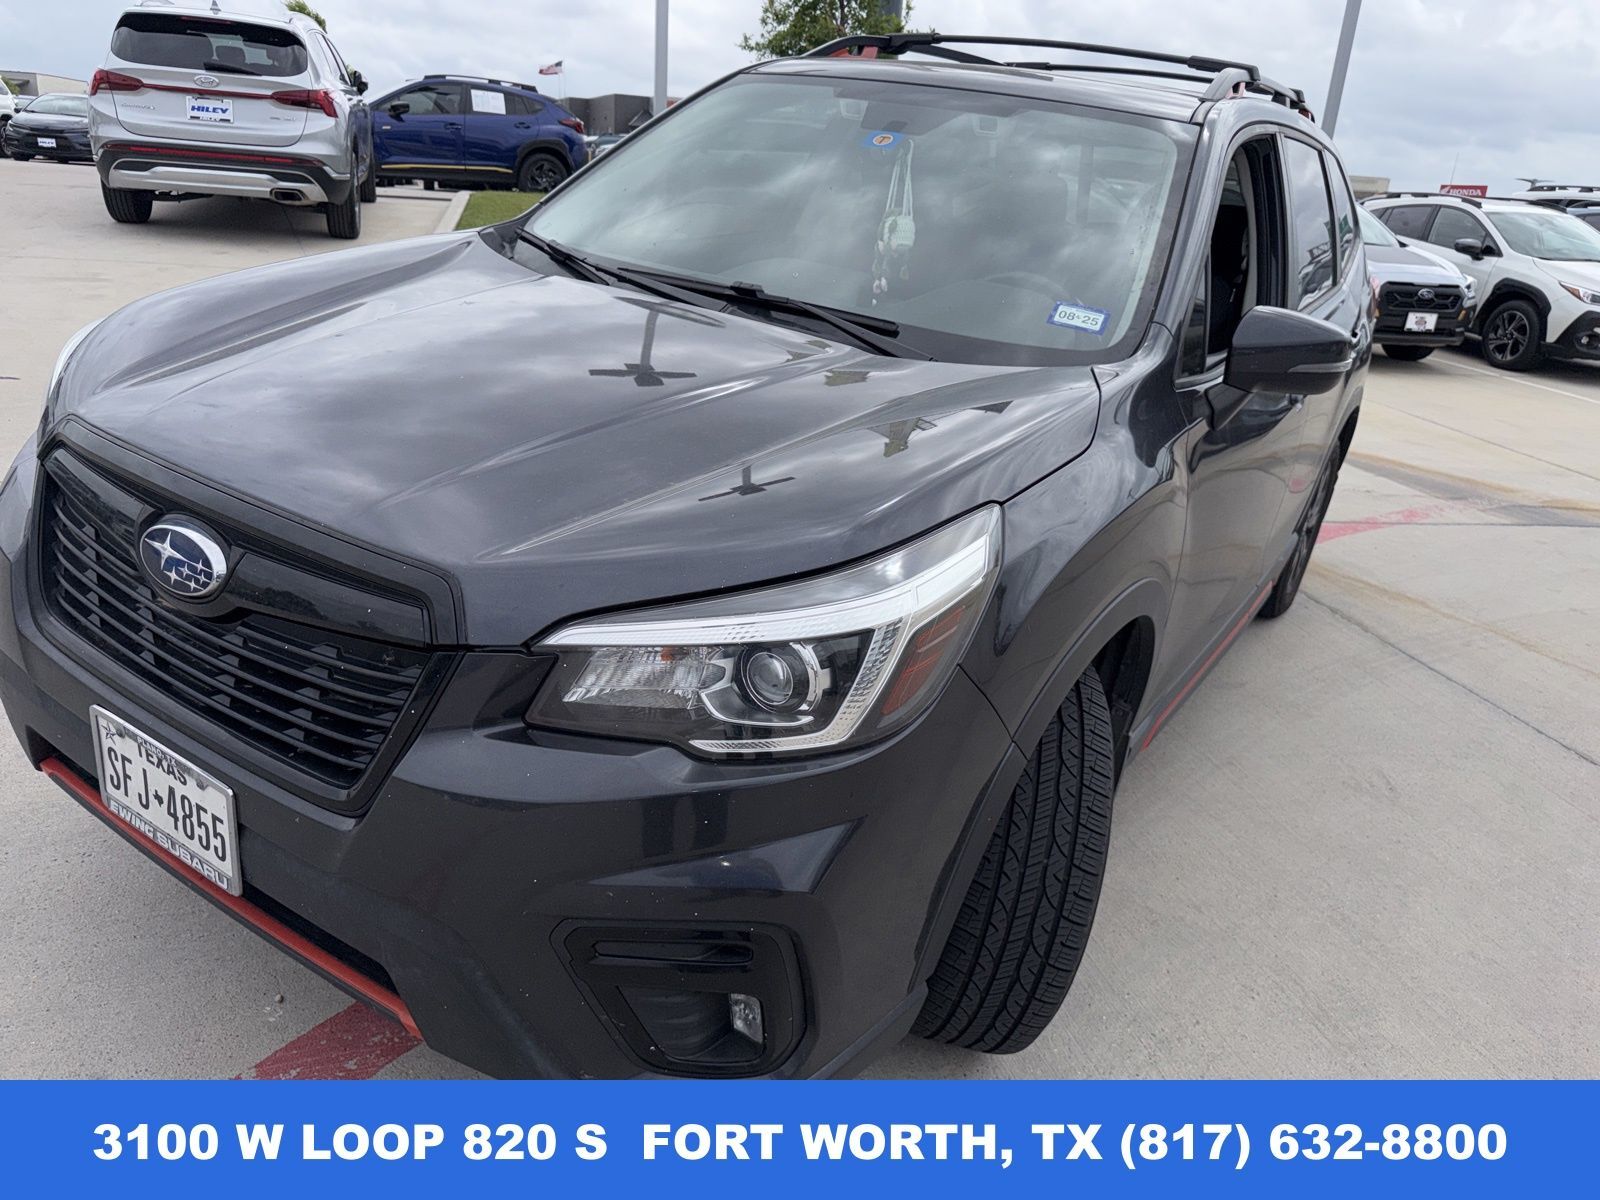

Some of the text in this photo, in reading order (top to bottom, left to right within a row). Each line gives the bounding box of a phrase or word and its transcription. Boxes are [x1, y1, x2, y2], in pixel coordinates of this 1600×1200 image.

[190, 105, 229, 114] HILEY
[1450, 188, 1482, 196] HONDA
[137, 742, 188, 787] TEXAS
[156, 831, 229, 890] SUBARU
